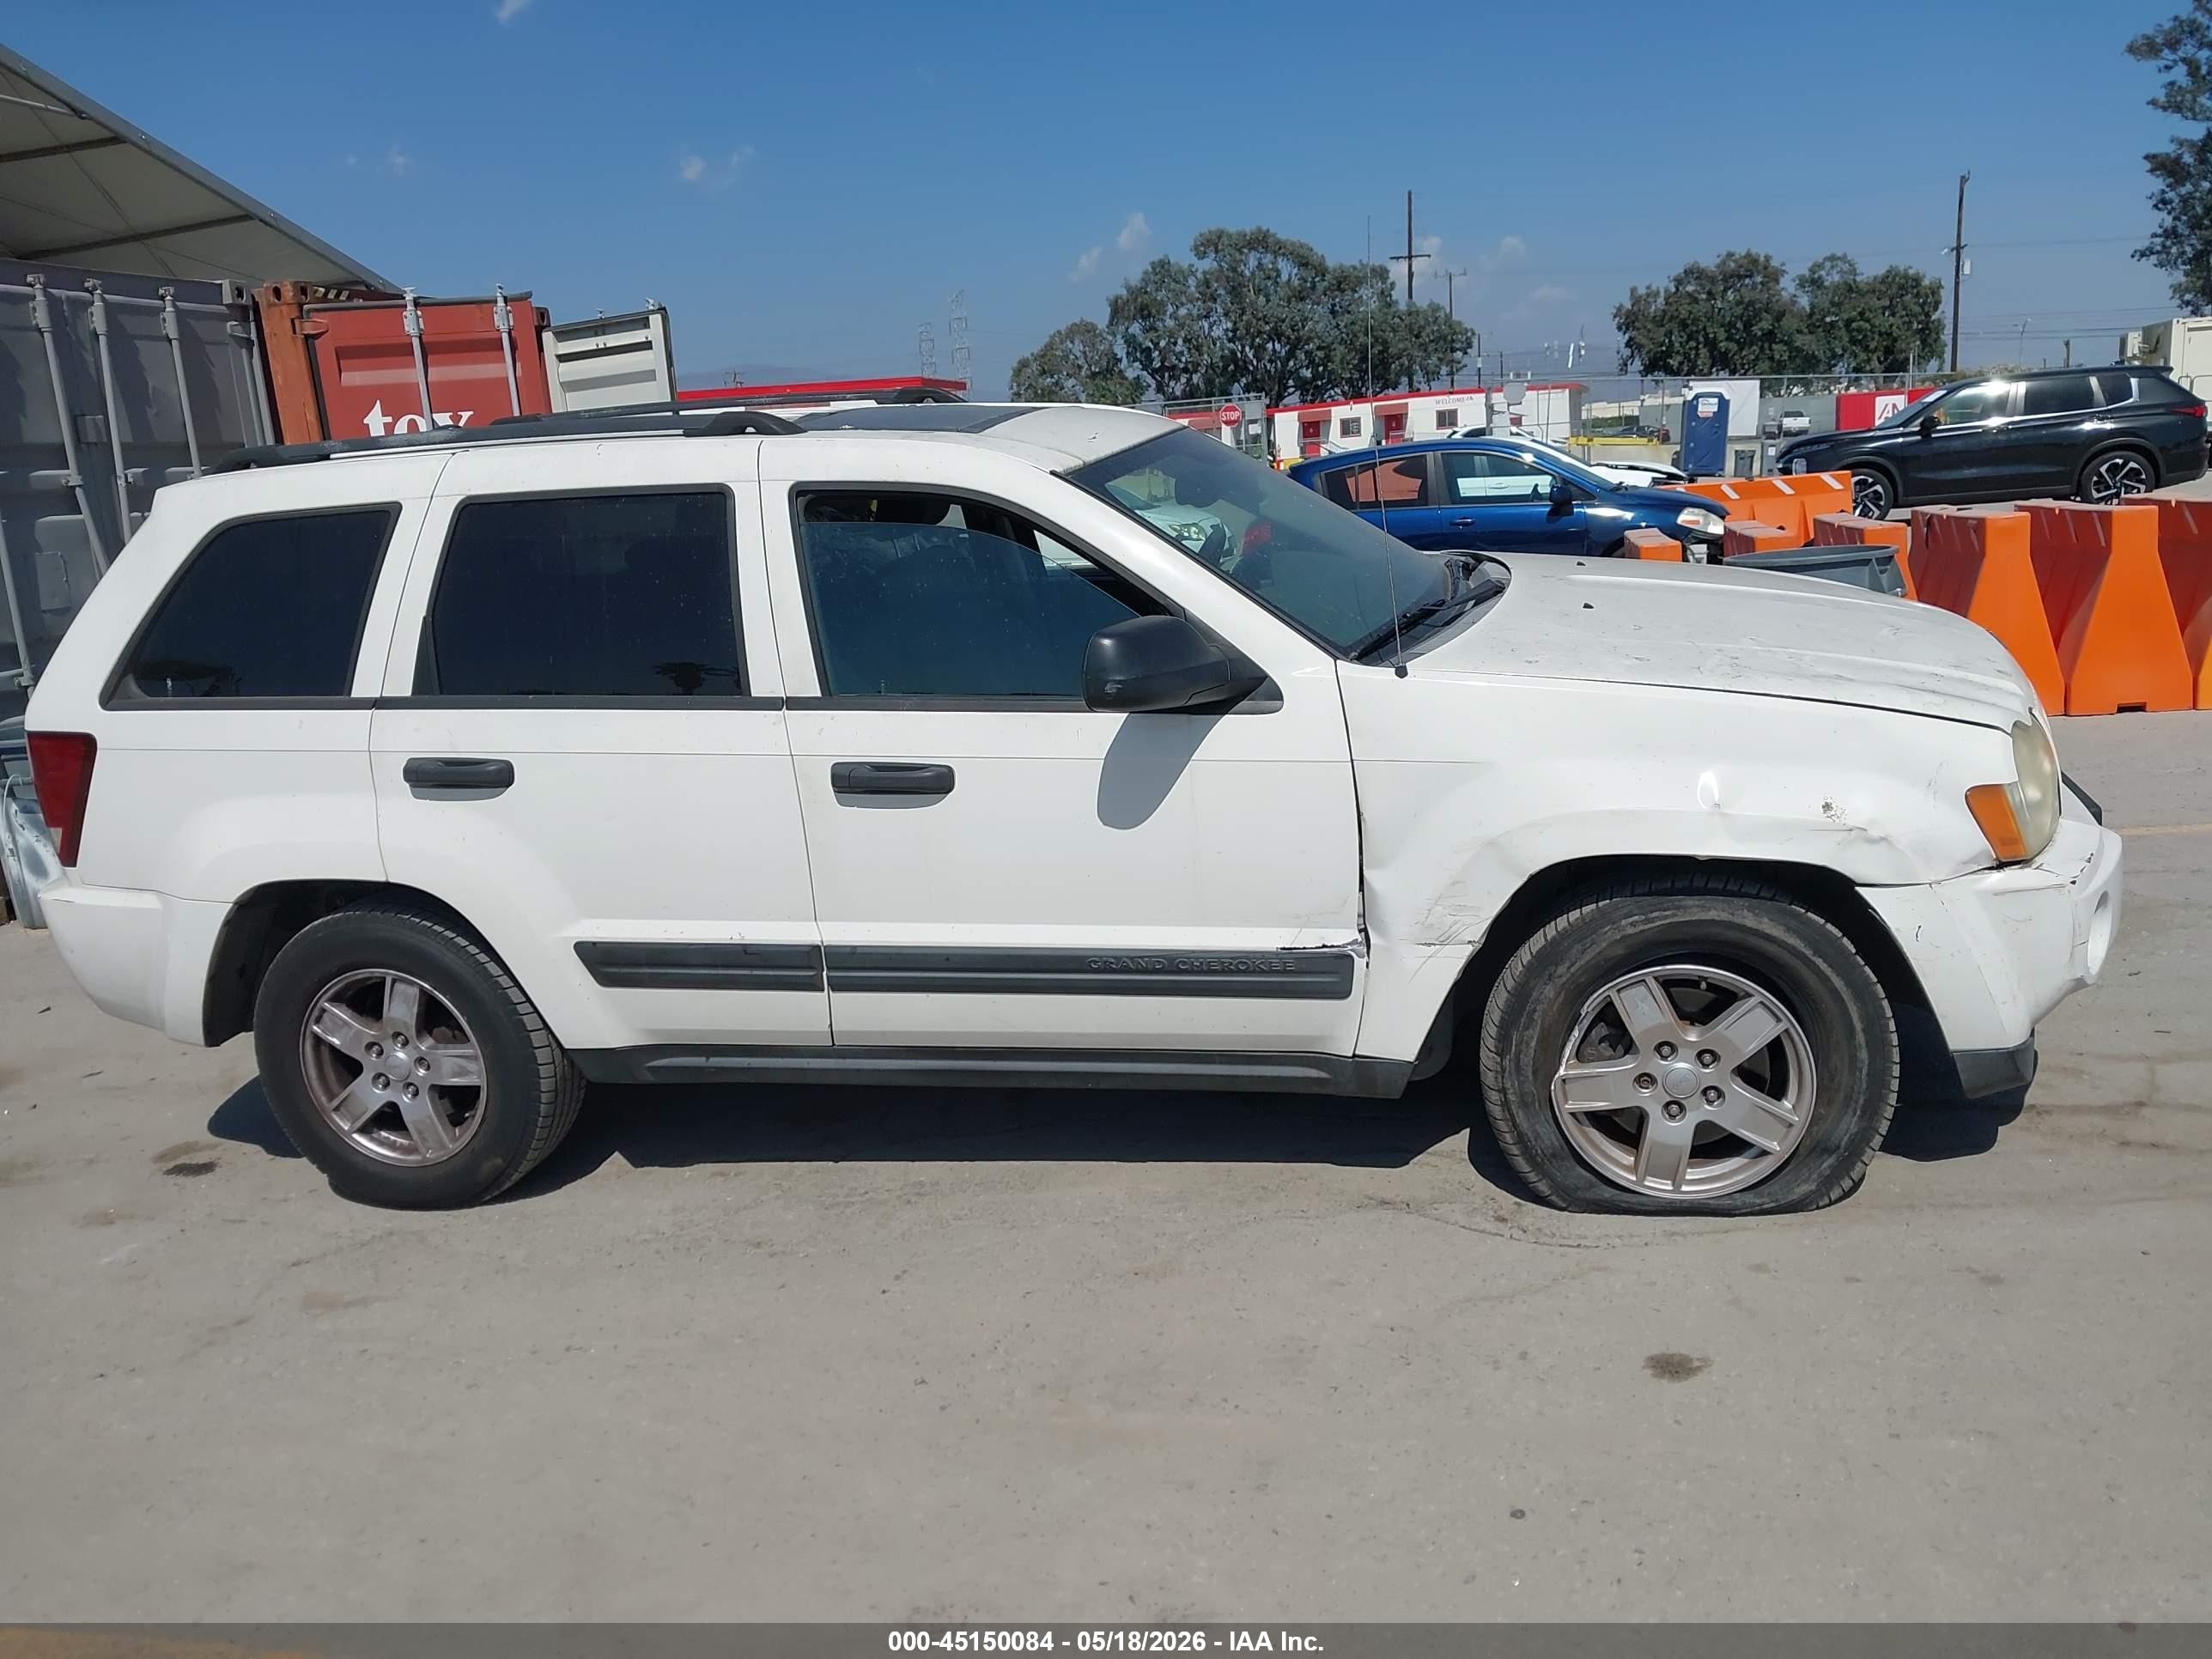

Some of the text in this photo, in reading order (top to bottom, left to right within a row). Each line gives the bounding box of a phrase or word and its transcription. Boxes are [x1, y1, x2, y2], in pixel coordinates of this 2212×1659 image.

[1221, 410, 1240, 421] STOP
[1086, 957, 1297, 972] GRAND CHEROKEE
